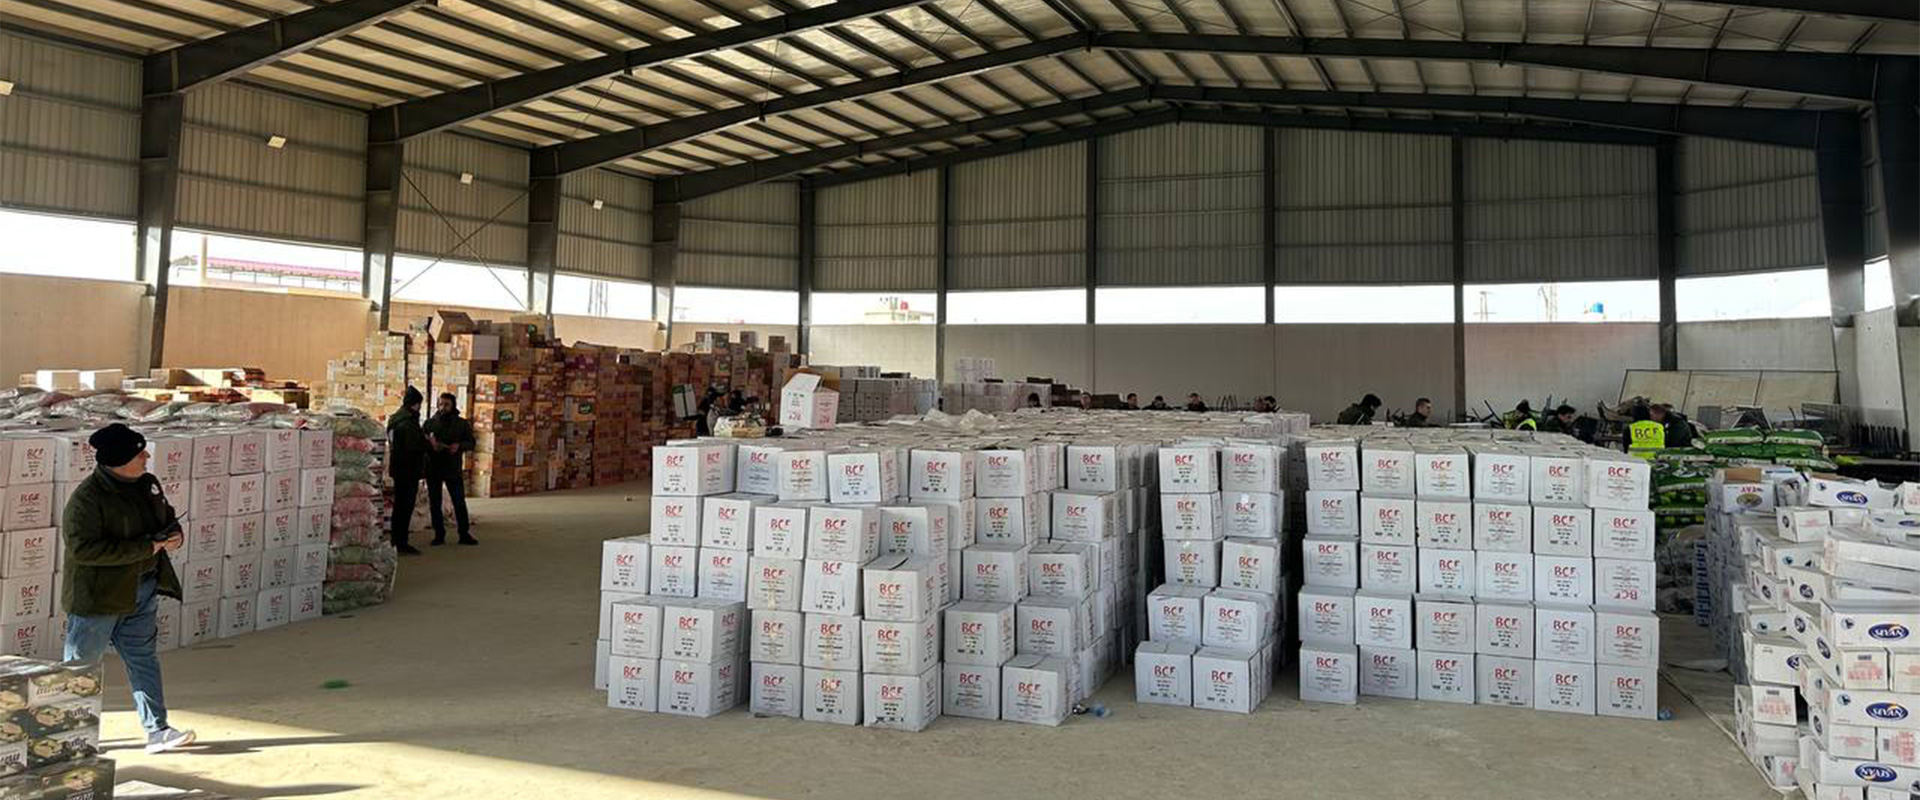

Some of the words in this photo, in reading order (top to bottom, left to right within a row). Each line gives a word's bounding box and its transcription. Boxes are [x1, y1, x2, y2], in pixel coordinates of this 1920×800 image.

[666, 455, 684, 467] BCF
[751, 453, 768, 463] BCF
[988, 457, 1008, 466] BCF
[1083, 454, 1101, 464] BCF
[1175, 455, 1193, 465] BCF
[1235, 454, 1255, 462] BCF
[1321, 452, 1340, 462] BCF
[791, 460, 811, 469] BCF
[927, 462, 946, 472] BCF
[1378, 459, 1399, 469] BCF
[1431, 461, 1452, 470] BCF
[1493, 464, 1513, 474] BCF
[846, 464, 864, 475] BCF
[1549, 466, 1570, 476] BCF
[1608, 467, 1631, 477] BCF
[1177, 501, 1195, 511] BCF
[1236, 502, 1256, 512] BCF
[1322, 500, 1341, 509] BCF
[666, 505, 682, 516] BCF
[719, 507, 736, 519] BCF
[990, 508, 1007, 517] BCF
[1067, 506, 1086, 516] BCF
[1379, 508, 1399, 520] BCF
[1435, 513, 1455, 524] BCF
[1489, 511, 1512, 521] BCF
[1553, 515, 1574, 526] BCF
[771, 518, 790, 530] BCF
[825, 518, 846, 530] BCF
[893, 522, 912, 533] BCF
[1613, 518, 1637, 528] BCF
[1318, 545, 1338, 554] BCF
[617, 555, 634, 565] BCF
[664, 556, 682, 566] BCF
[713, 556, 732, 566] BCF
[1180, 554, 1198, 563] BCF
[1377, 551, 1398, 561] BCF
[1239, 557, 1258, 566] BCF
[1439, 560, 1459, 570] BCF
[822, 562, 842, 574] BCF
[977, 564, 998, 573] BCF
[1043, 564, 1063, 573] BCF
[1495, 563, 1516, 572] BCF
[1554, 567, 1575, 577] BCF
[763, 568, 785, 579] BCF
[880, 584, 900, 594] BCF
[1164, 606, 1183, 615] BCF
[1316, 603, 1337, 612] BCF
[624, 612, 643, 623] BCF
[1219, 609, 1240, 618] BCF
[1371, 608, 1392, 618] BCF
[1434, 612, 1455, 622] BCF
[679, 616, 698, 629] BCF
[763, 622, 783, 633] BCF
[1032, 619, 1052, 630] BCF
[1495, 617, 1518, 628] BCF
[1553, 621, 1576, 631] BCF
[820, 623, 842, 634] BCF
[961, 623, 982, 633] BCF
[1616, 626, 1640, 637] BCF
[878, 629, 899, 640] BCF
[1316, 658, 1338, 668] BCF
[1373, 656, 1395, 666] BCF
[1436, 660, 1457, 670] BCF
[624, 666, 641, 678] BCF
[674, 670, 692, 682] BCF
[1154, 666, 1175, 676] BCF
[1212, 671, 1232, 681] BCF
[1495, 669, 1517, 679] BCF
[764, 675, 784, 686] BCF
[959, 673, 981, 683] BCF
[1555, 675, 1578, 685] BCF
[822, 679, 841, 690] BCF
[1018, 683, 1040, 694] BCF
[1617, 678, 1640, 689] BCF
[881, 686, 903, 697] BCF
